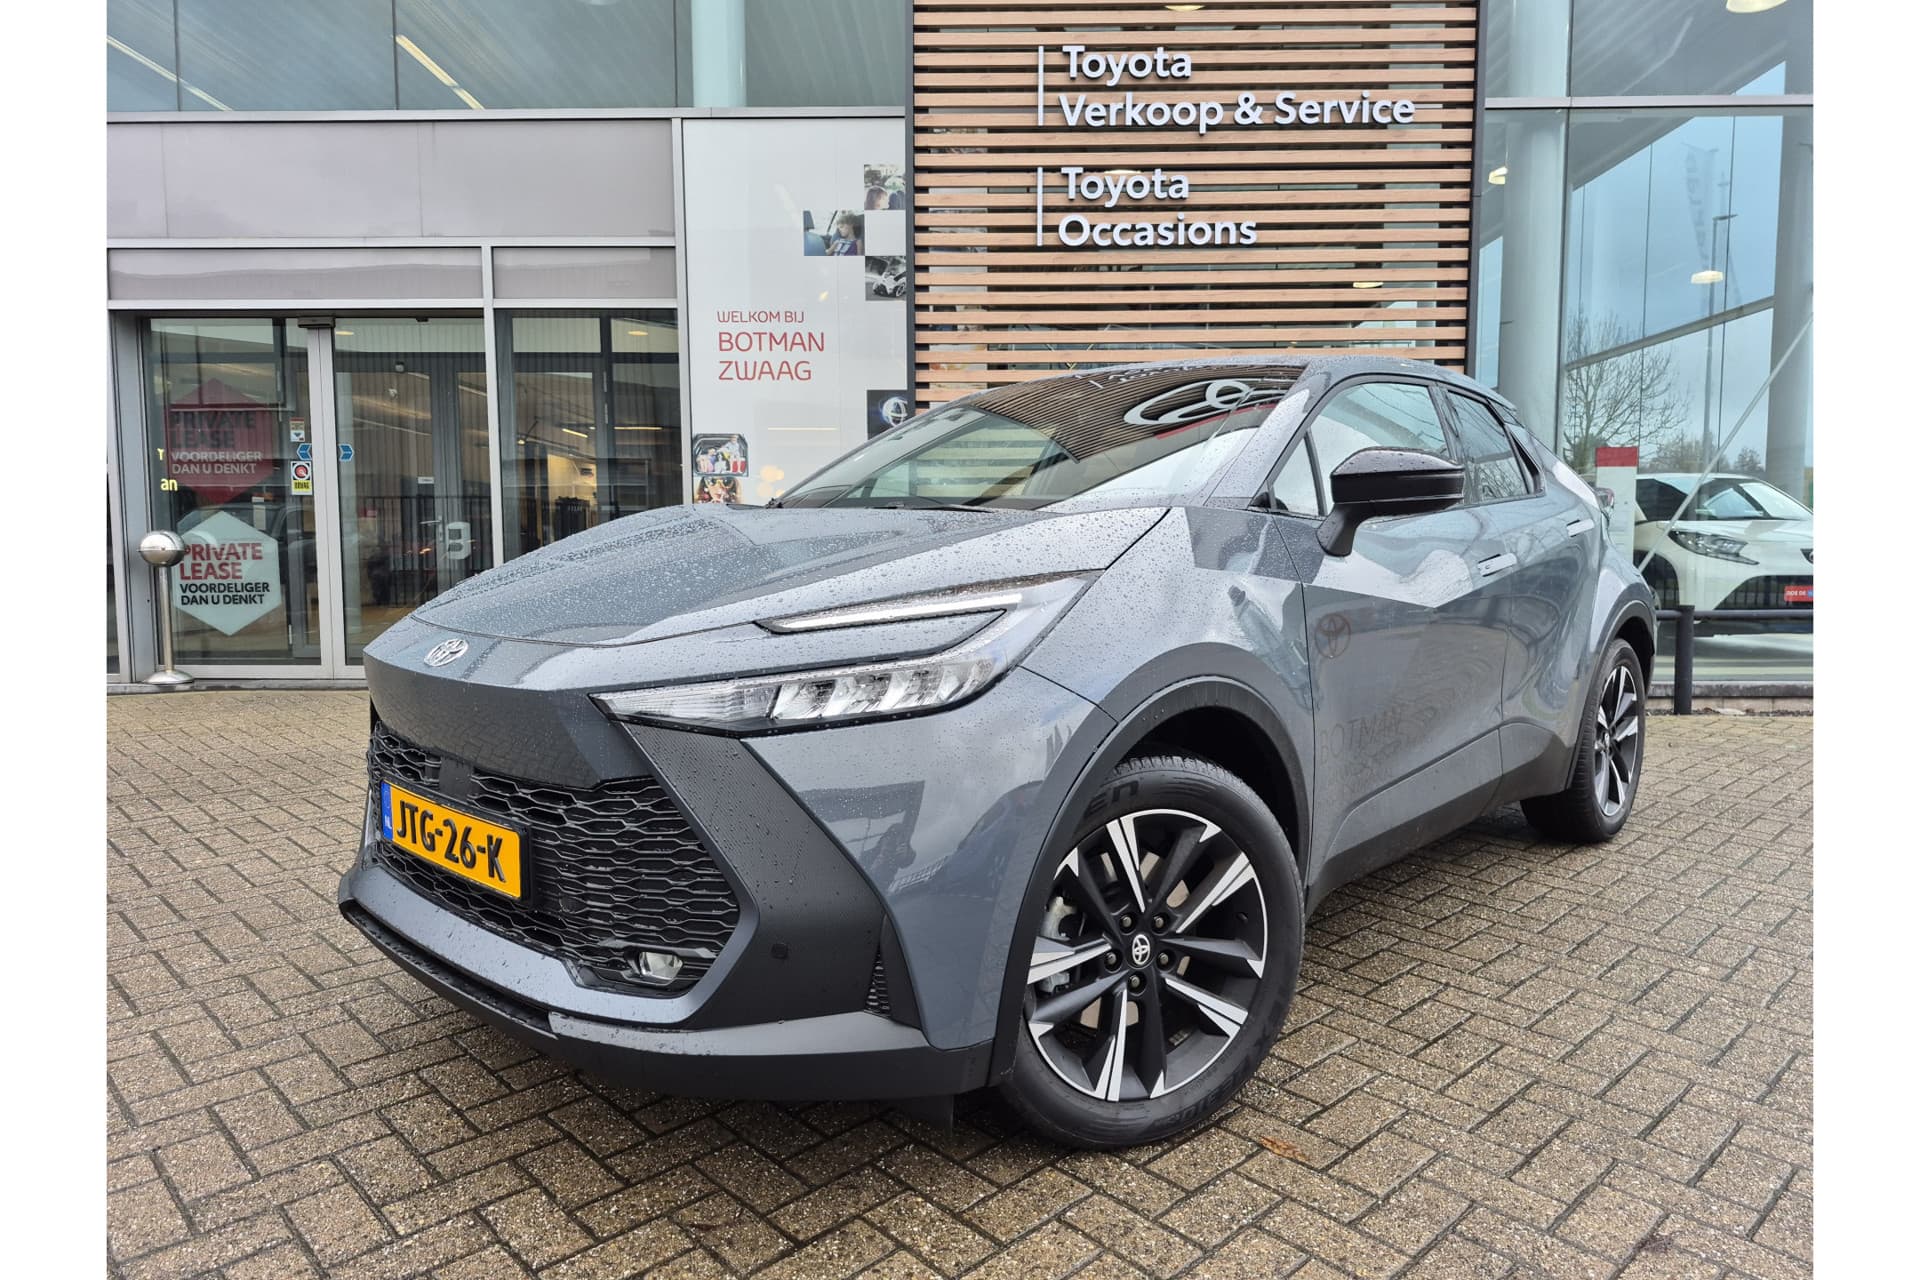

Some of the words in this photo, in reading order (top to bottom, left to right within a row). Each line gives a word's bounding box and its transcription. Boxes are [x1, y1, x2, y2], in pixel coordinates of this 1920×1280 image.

[1062, 45, 1192, 86] Toyota
[1058, 92, 1224, 135] Verkoop
[1233, 91, 1263, 125] &
[1274, 90, 1416, 125] Service
[1060, 166, 1190, 208] Toyota
[1058, 212, 1257, 247] Occasions
[717, 310, 780, 323] WELKOM
[784, 310, 805, 323] BIJ
[719, 331, 824, 352] BOTMAN
[719, 360, 812, 381] ZWAAG
[169, 411, 256, 428] PRIVATE
[169, 431, 235, 448] LEASE
[171, 451, 262, 462] VOORDELIGER
[172, 463, 200, 474] DAN
[202, 463, 212, 474] U
[214, 463, 257, 474] DENKT
[179, 562, 242, 580] LEASE
[180, 582, 270, 593] VOORDELIGER
[181, 595, 209, 605] DAN
[211, 594, 220, 605] U
[223, 594, 265, 605] DENKT
[397, 800, 507, 882] JTG-26-K
